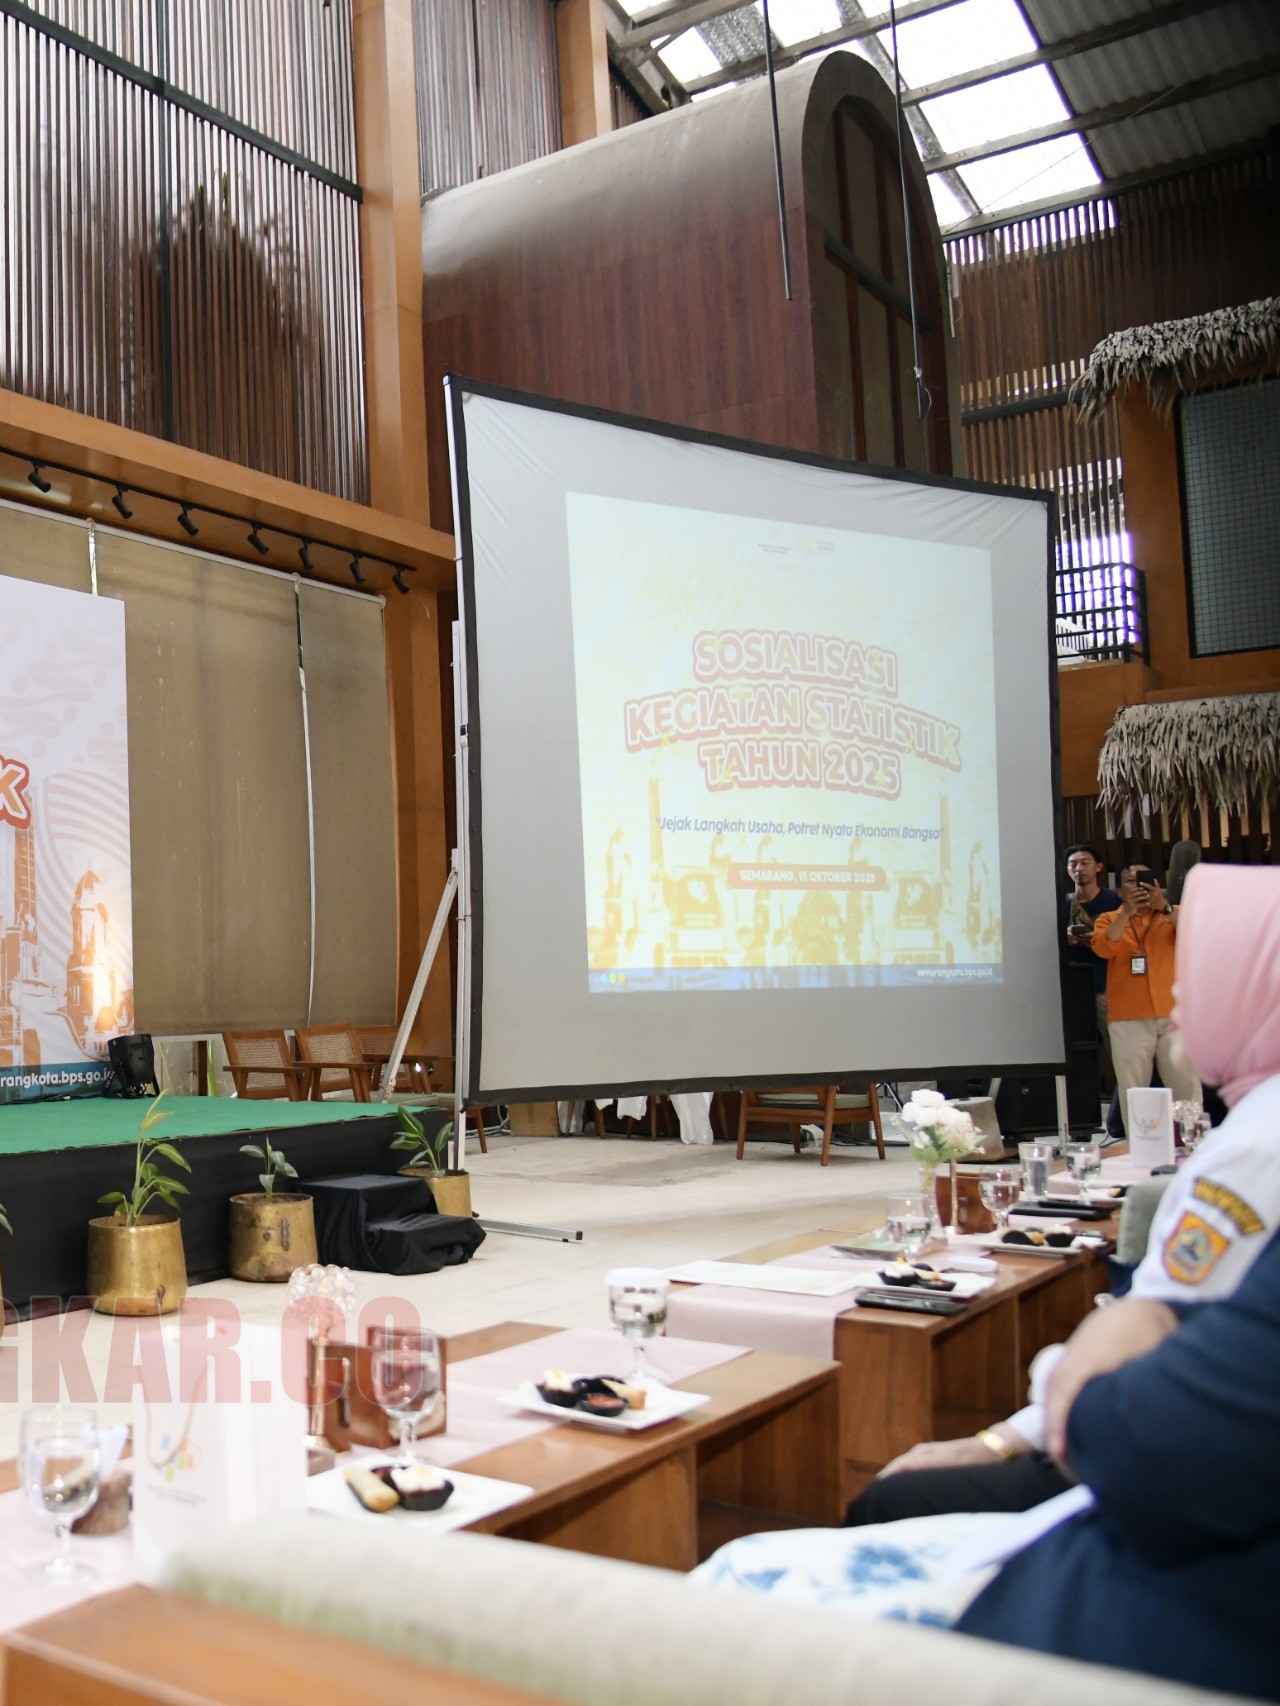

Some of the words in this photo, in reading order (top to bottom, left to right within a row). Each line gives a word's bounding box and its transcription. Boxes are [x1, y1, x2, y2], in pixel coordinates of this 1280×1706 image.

[695, 632, 895, 692] SOSIALISASI
[626, 687, 800, 745] KEGIATAN
[805, 689, 962, 766] STATISTIK
[701, 739, 820, 785] TAHUN
[822, 744, 899, 793] 2025
[694, 818, 745, 834] Langkah
[748, 820, 786, 836] Usaha,
[787, 821, 821, 836] Potret
[821, 822, 853, 839] Nyata
[855, 823, 901, 839] Ekonomi
[739, 869, 797, 882] SEMARANG,
[799, 871, 808, 882] 15
[810, 871, 852, 883] OKTOBER
[854, 872, 876, 883] 2025
